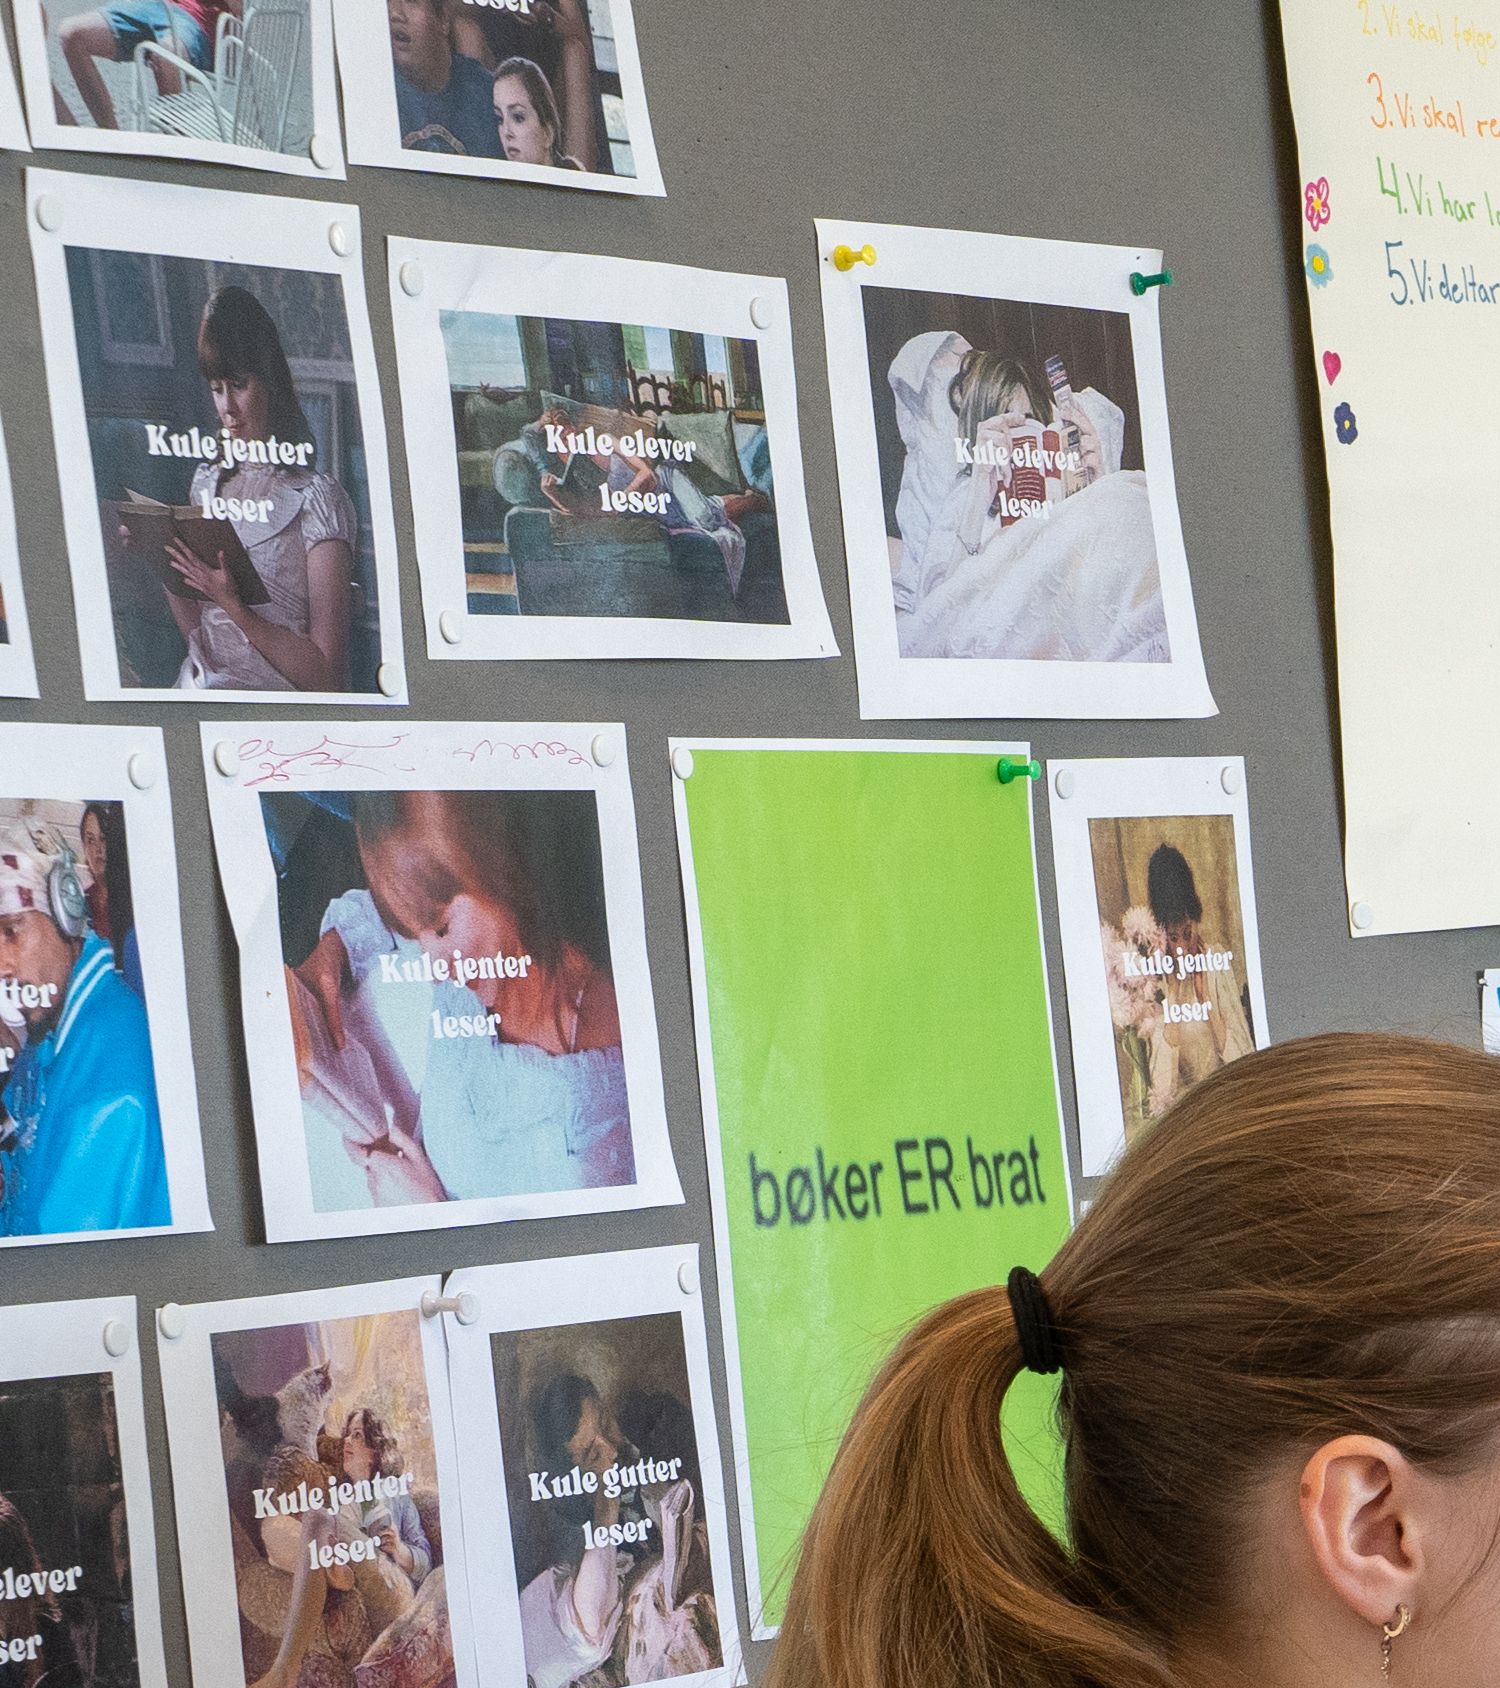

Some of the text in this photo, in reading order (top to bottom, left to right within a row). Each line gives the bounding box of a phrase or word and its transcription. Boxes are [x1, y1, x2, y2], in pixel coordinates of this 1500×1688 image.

[1405, 11, 1442, 46] skal
[1452, 14, 1496, 65] følge
[1421, 96, 1466, 138] skal
[1439, 182, 1476, 222] har
[145, 423, 314, 470] Kule jenter
[544, 423, 698, 464] Kule elever
[955, 437, 1082, 473] Kule elever
[199, 489, 276, 526] leser
[598, 482, 672, 516] leser
[999, 490, 1053, 521] leser
[378, 951, 532, 987] Kule jenter
[1121, 948, 1234, 981] Kule jenter
[0, 977, 58, 1011] tter
[1161, 998, 1213, 1026] leser
[430, 1007, 501, 1040] leser
[748, 1134, 1047, 1230] bøker ER brat
[252, 1466, 414, 1521] Kule jenter
[528, 1453, 682, 1502] Kule gutter
[582, 1516, 653, 1552] leser
[308, 1533, 383, 1573] leser
[0, 1631, 43, 1666] ser
